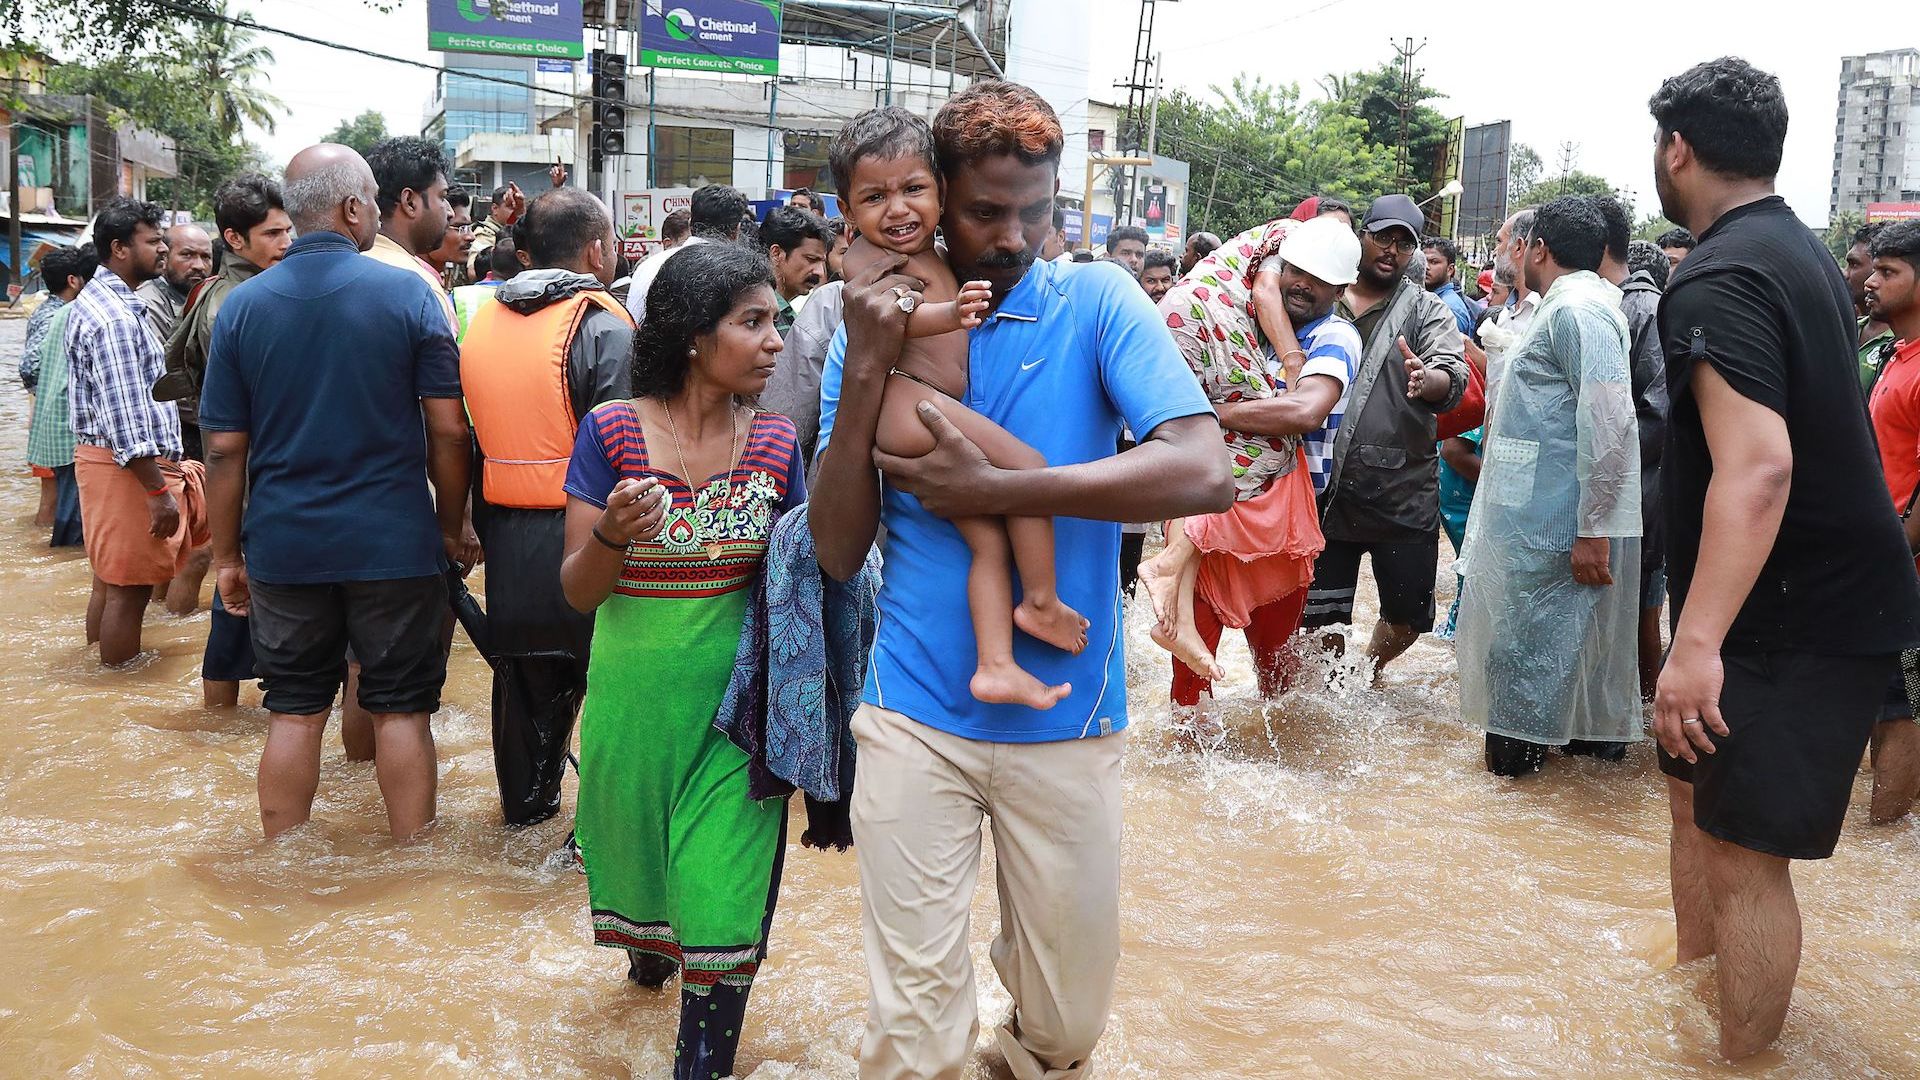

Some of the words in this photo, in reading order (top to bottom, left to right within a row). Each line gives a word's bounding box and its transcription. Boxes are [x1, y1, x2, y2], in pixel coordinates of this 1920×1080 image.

[699, 17, 757, 34] Chettinad
[699, 32, 733, 41] cement
[448, 36, 486, 48] Perfect
[488, 39, 534, 52] Concrete
[535, 42, 569, 54] Choice
[656, 55, 691, 66] Perfect
[692, 57, 733, 69] Concrete
[735, 60, 764, 71] Choice
